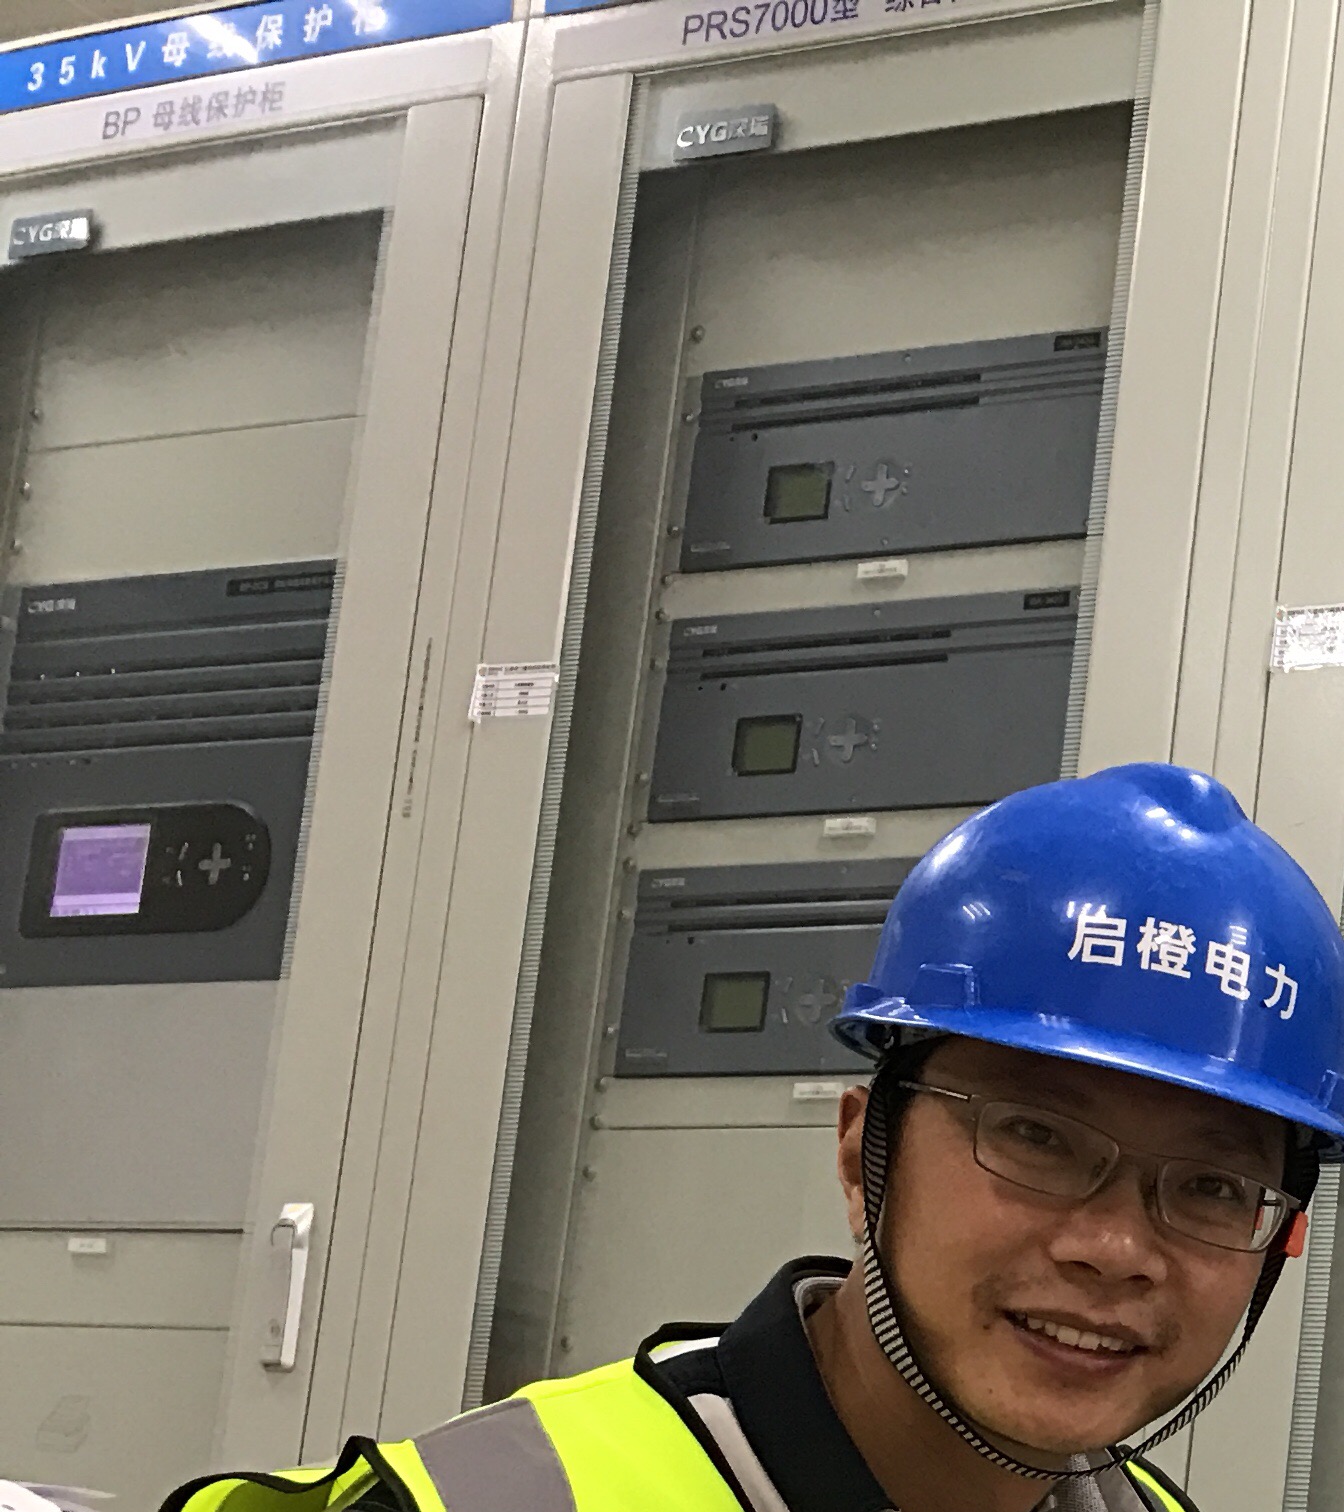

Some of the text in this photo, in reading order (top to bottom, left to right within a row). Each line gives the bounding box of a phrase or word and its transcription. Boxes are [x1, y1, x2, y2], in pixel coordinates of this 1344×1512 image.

[101, 81, 286, 140] BP 母线保护柜
[1067, 912, 1299, 1021] 启橙电力
